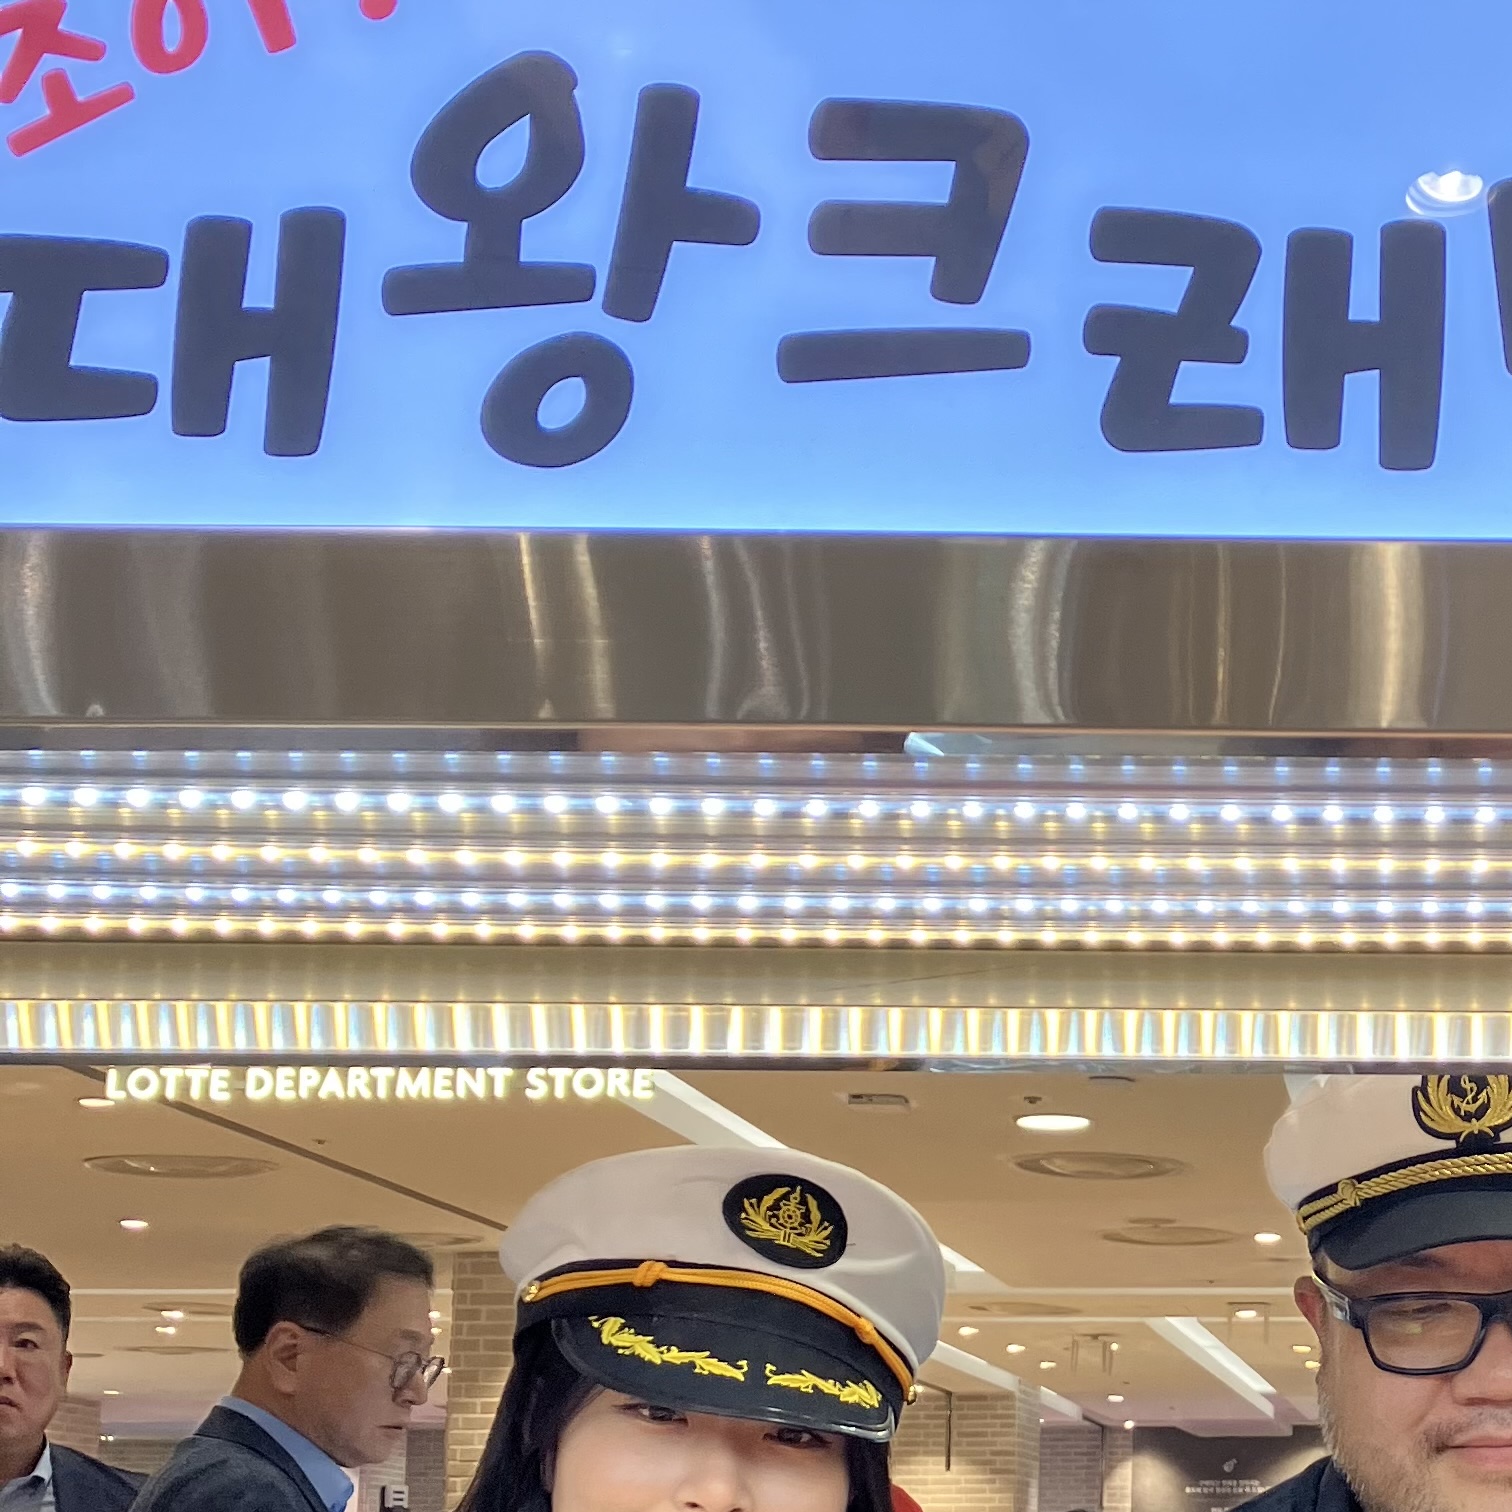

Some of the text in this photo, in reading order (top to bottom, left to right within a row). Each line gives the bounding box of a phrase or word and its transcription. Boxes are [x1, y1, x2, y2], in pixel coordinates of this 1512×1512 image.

[105, 1066, 656, 1100] LOTTE DEPARTMENT STORE
